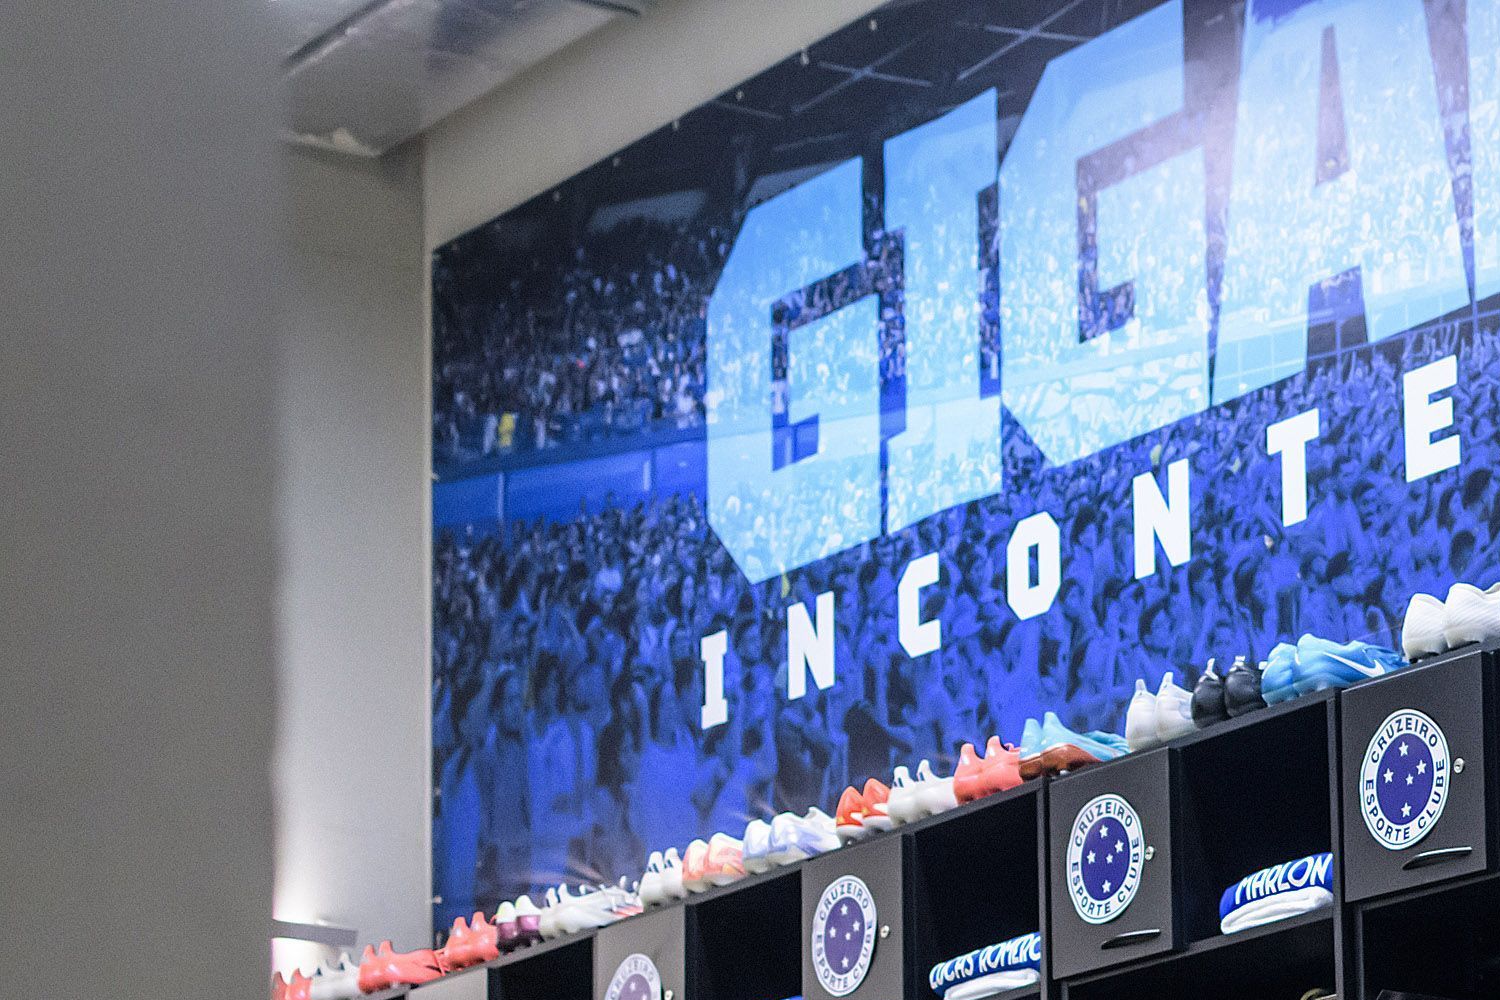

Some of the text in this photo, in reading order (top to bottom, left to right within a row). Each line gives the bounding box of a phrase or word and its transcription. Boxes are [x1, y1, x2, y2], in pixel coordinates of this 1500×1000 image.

[1371, 717, 1438, 764] CRUZEIRO
[1075, 801, 1133, 847] CRUZEIRO
[1365, 758, 1445, 841] ESPORTE CLUBE
[819, 882, 868, 921] CRUZEIRO
[1072, 837, 1139, 916] ESPORTE CLUBE
[1235, 853, 1333, 904] MARLON
[817, 934, 848, 988] ESPORTE
